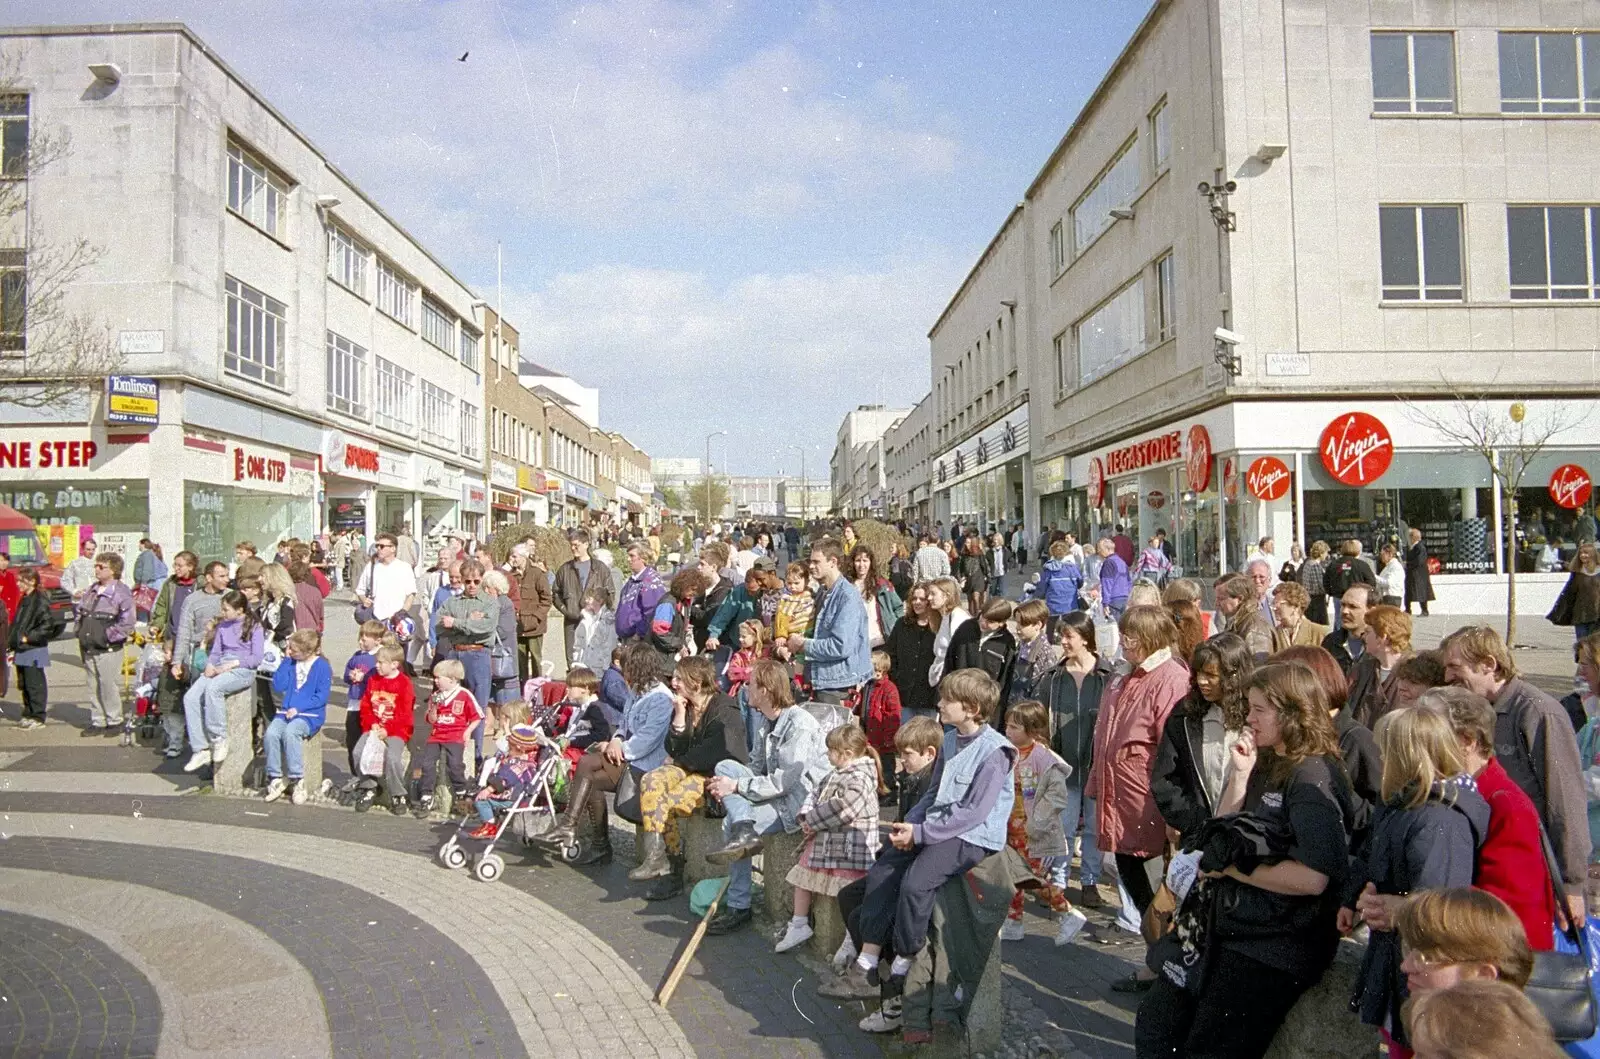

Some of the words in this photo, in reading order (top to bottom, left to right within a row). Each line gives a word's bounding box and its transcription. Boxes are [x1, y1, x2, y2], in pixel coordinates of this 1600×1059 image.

[111, 376, 157, 395] Tomlinson
[39, 441, 97, 468] STEP
[1106, 430, 1182, 475] MEGASTORE
[1325, 415, 1389, 481] Virgin
[246, 455, 266, 480] ONE
[267, 459, 287, 483] STEP
[1249, 459, 1289, 499] Virgin
[1551, 467, 1590, 506] Virgin
[1446, 561, 1495, 569] MEGASTORE
